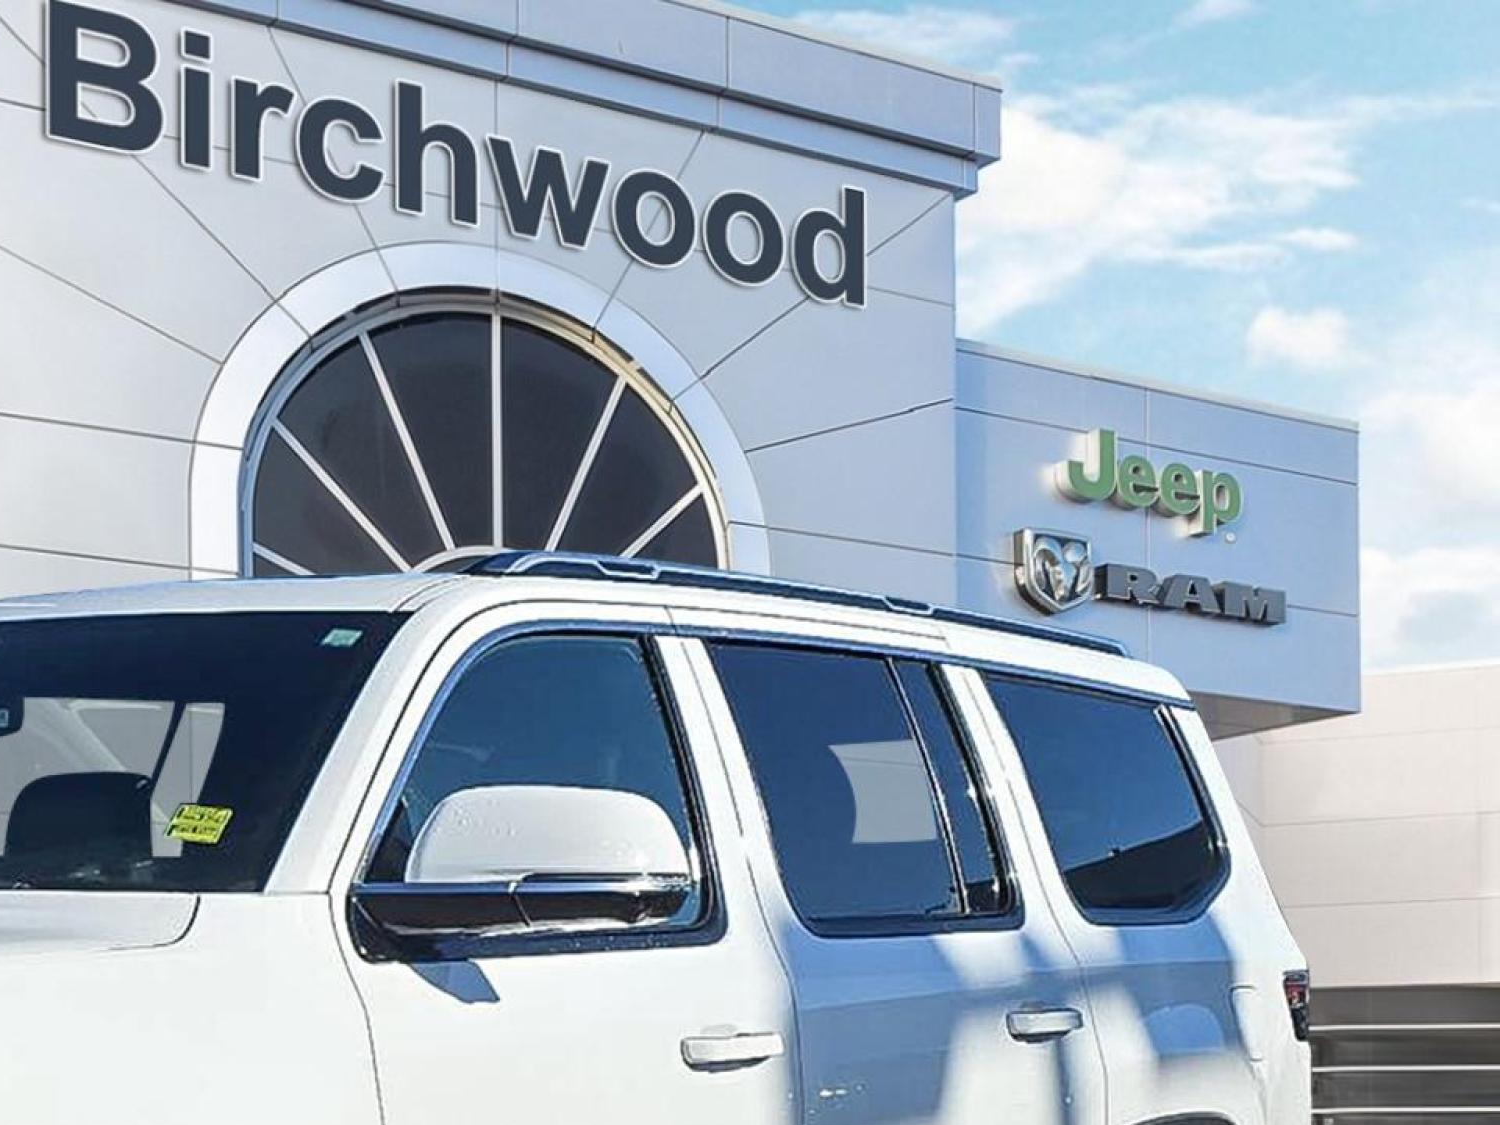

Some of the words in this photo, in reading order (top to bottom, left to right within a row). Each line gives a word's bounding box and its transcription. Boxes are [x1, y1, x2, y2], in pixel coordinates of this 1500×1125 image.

[44, 0, 867, 308] Birchwood
[1056, 427, 1244, 537] Jeep
[1094, 562, 1287, 625] RAM
